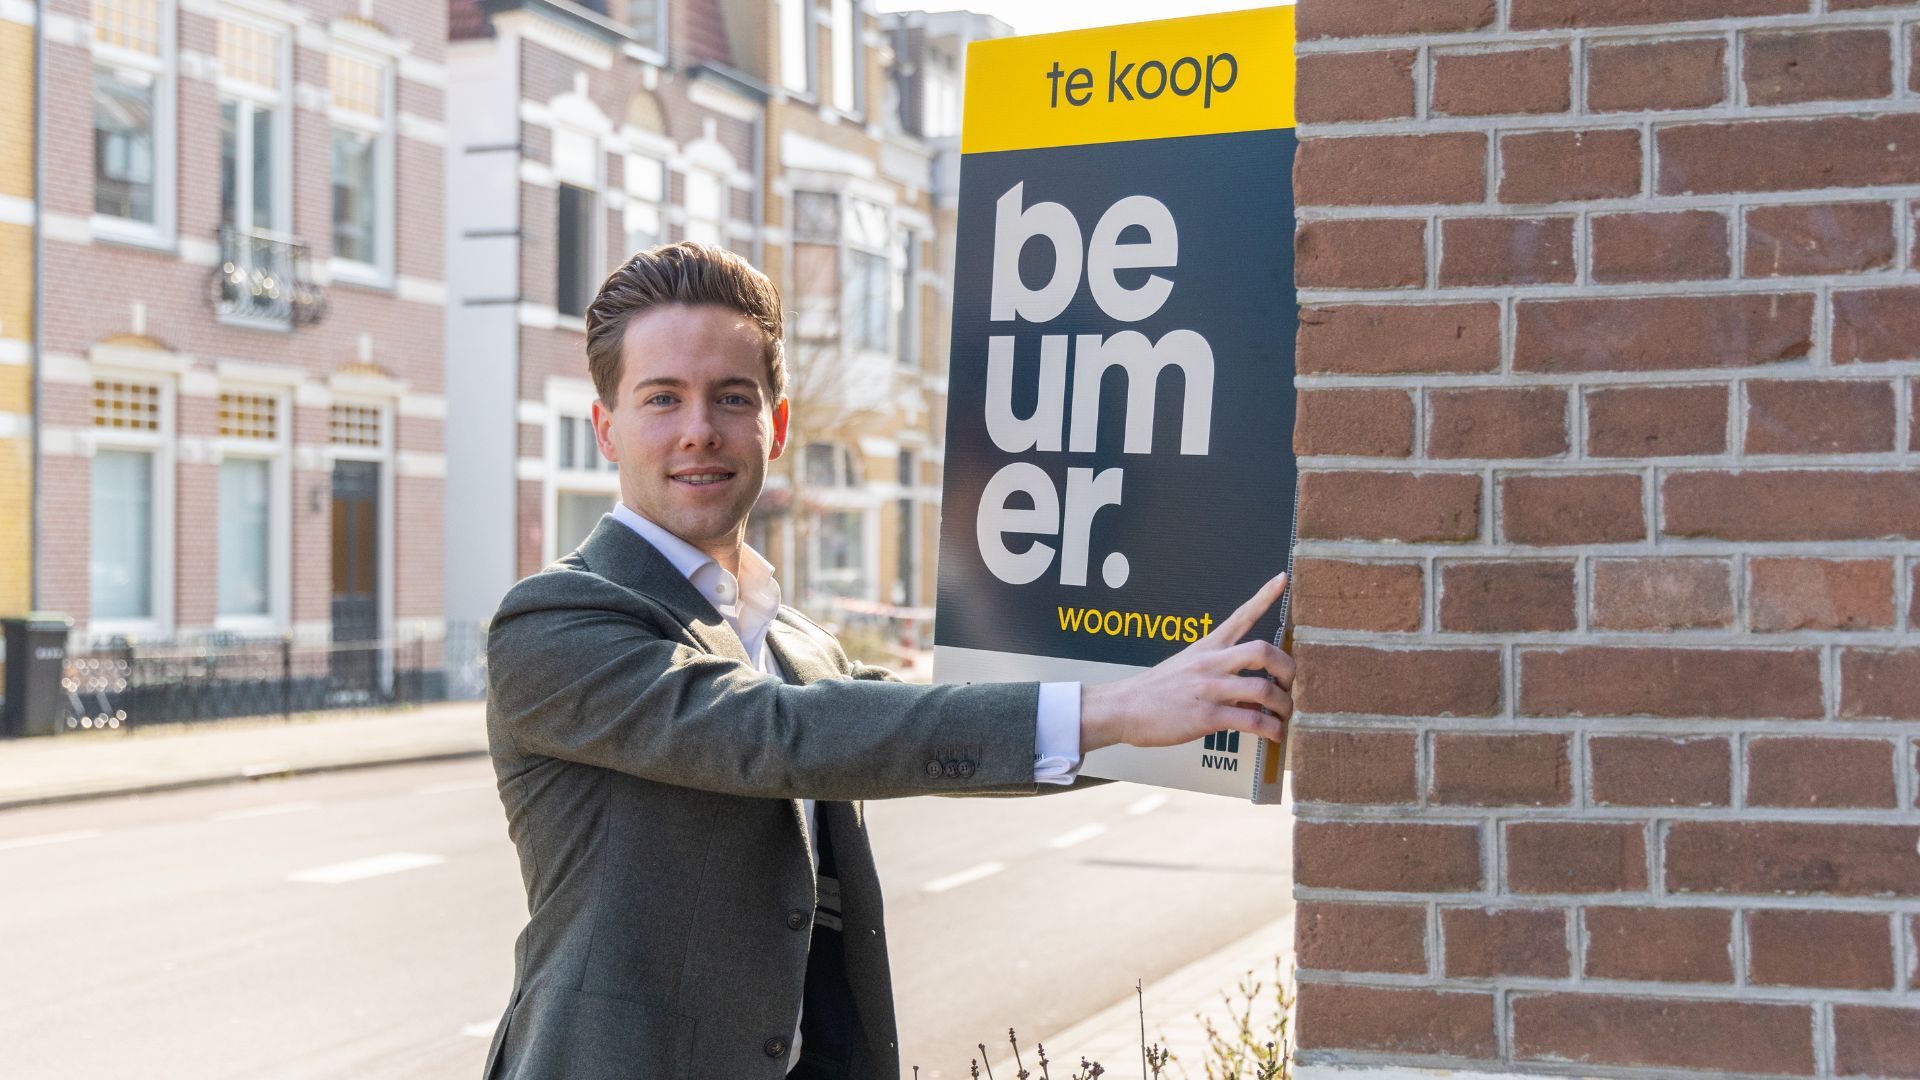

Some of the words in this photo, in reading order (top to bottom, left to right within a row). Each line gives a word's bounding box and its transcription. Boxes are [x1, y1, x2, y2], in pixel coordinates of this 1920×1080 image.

[1046, 61, 1094, 107] te
[1108, 50, 1238, 109] koop
[990, 180, 1179, 323] be
[985, 329, 1215, 455] um
[976, 462, 1130, 589] er.
[1057, 606, 1213, 643] woonvast
[1201, 754, 1238, 772] NVM
